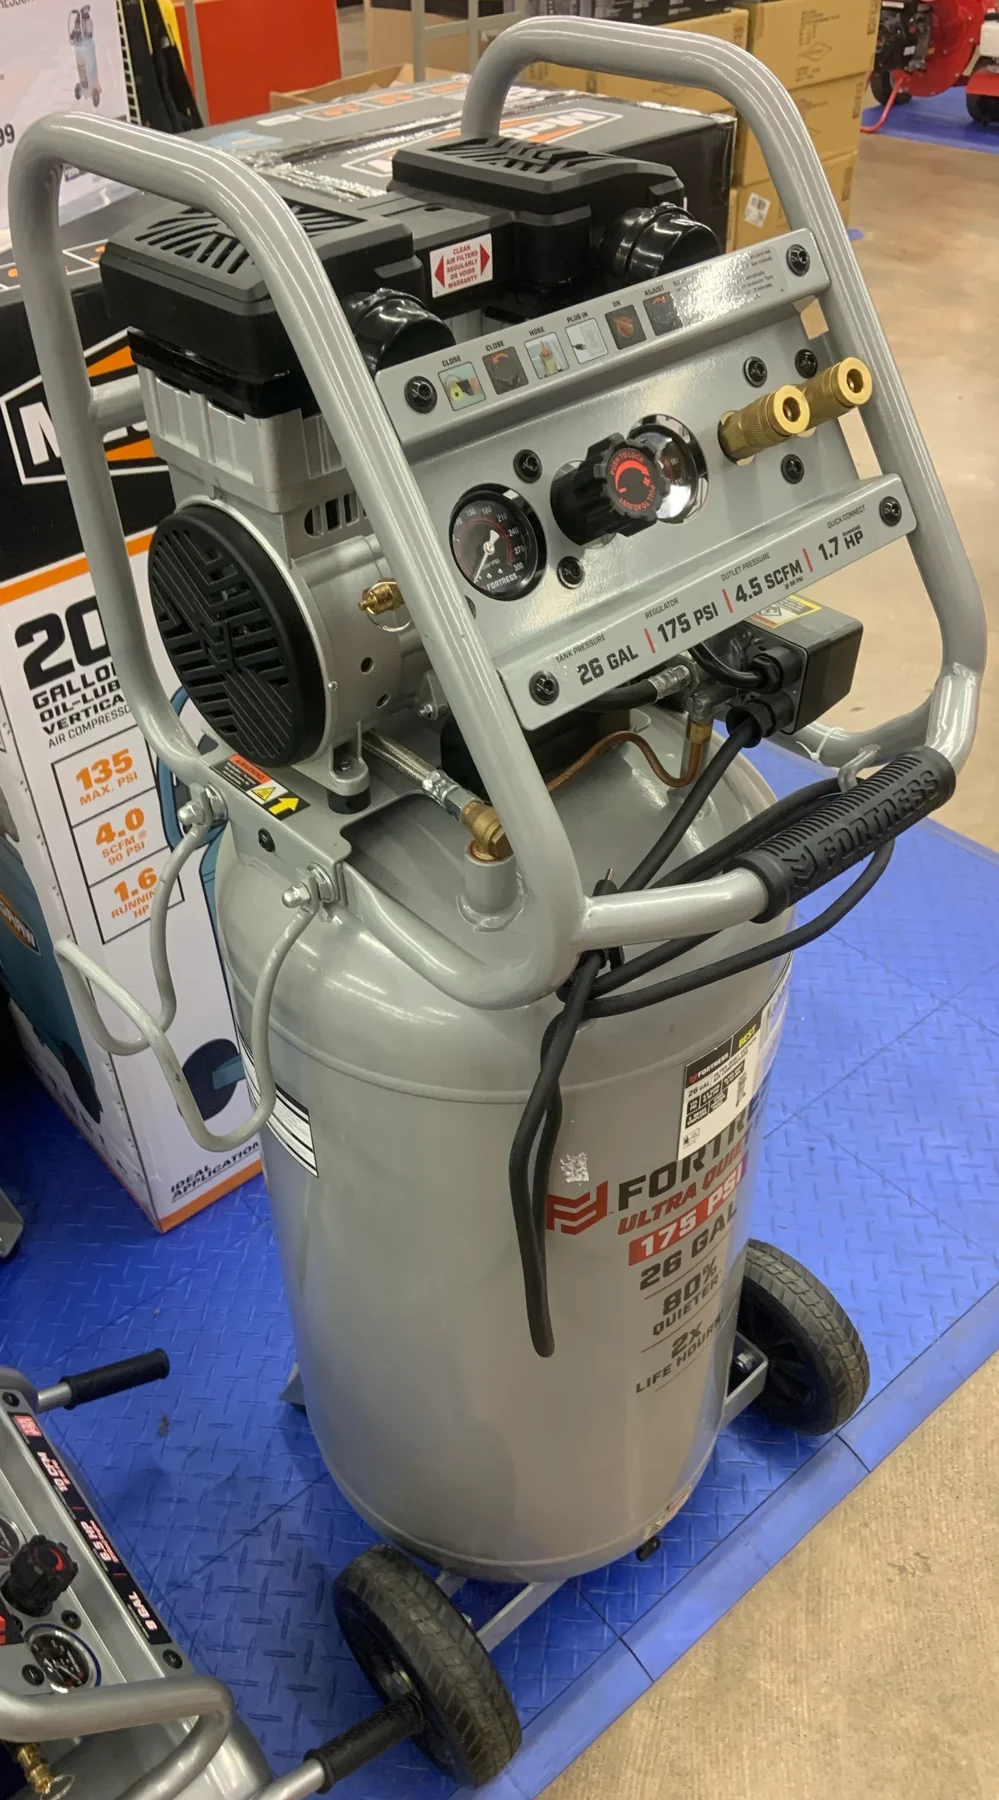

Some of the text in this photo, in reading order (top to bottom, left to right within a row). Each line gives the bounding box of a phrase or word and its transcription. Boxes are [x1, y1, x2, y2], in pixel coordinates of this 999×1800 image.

[446, 250, 478, 266] AIR FILTERS
[452, 244, 471, 255] CLEAN
[447, 259, 478, 273] REGULARLY
[448, 275, 477, 289] WARRANTY
[644, 285, 664, 296] ADJUST
[529, 326, 545, 337] HOSE
[566, 314, 582, 323] PLUG
[442, 355, 462, 367] CLOSE
[486, 340, 505, 352] CLOSE
[609, 456, 621, 476] PUSH
[620, 451, 628, 460] TO
[497, 512, 508, 523] 210
[826, 504, 866, 529] QUICK CONNECT
[508, 527, 519, 537] 240
[818, 530, 864, 561] 1.7 HP
[513, 545, 525, 555] 270
[486, 572, 518, 591] FORTRESS
[513, 562, 524, 572] 300
[720, 552, 771, 582] OUTLET PRESSURE
[735, 559, 804, 603] 4.5 SCFM
[644, 597, 679, 620] REGULATOR
[657, 602, 719, 643] 175 PSI
[14, 594, 112, 692] 20
[555, 633, 606, 664] TANK PRESSURE
[576, 645, 639, 686] 26 GAL
[32, 661, 117, 711] GALLO
[39, 679, 121, 724] OIL-LUB
[42, 693, 125, 736] VERTICA
[48, 704, 132, 750] AIR COMPRESSO
[76, 748, 133, 791] 135
[79, 771, 138, 807] MAX. PSI
[95, 807, 145, 847] 4.0
[818, 769, 939, 870] FORTRESS
[101, 829, 147, 859] SCFM @
[108, 841, 145, 866] 90 PSI
[114, 867, 158, 902] 1.6
[111, 888, 156, 919] RUNNIN
[133, 904, 150, 919] HP
[698, 1052, 729, 1078] FORTRESS
[739, 1024, 757, 1048] BEST
[688, 1086, 698, 1098] 26
[171, 1165, 212, 1193] IDEAL
[617, 1181, 697, 1235] ULTRA
[640, 1160, 743, 1257] 175 PSI
[640, 1200, 738, 1290] 26 GAL
[663, 1256, 717, 1316] 80%
[636, 1363, 672, 1393] LIFE
[128, 1591, 151, 1618] GAL
